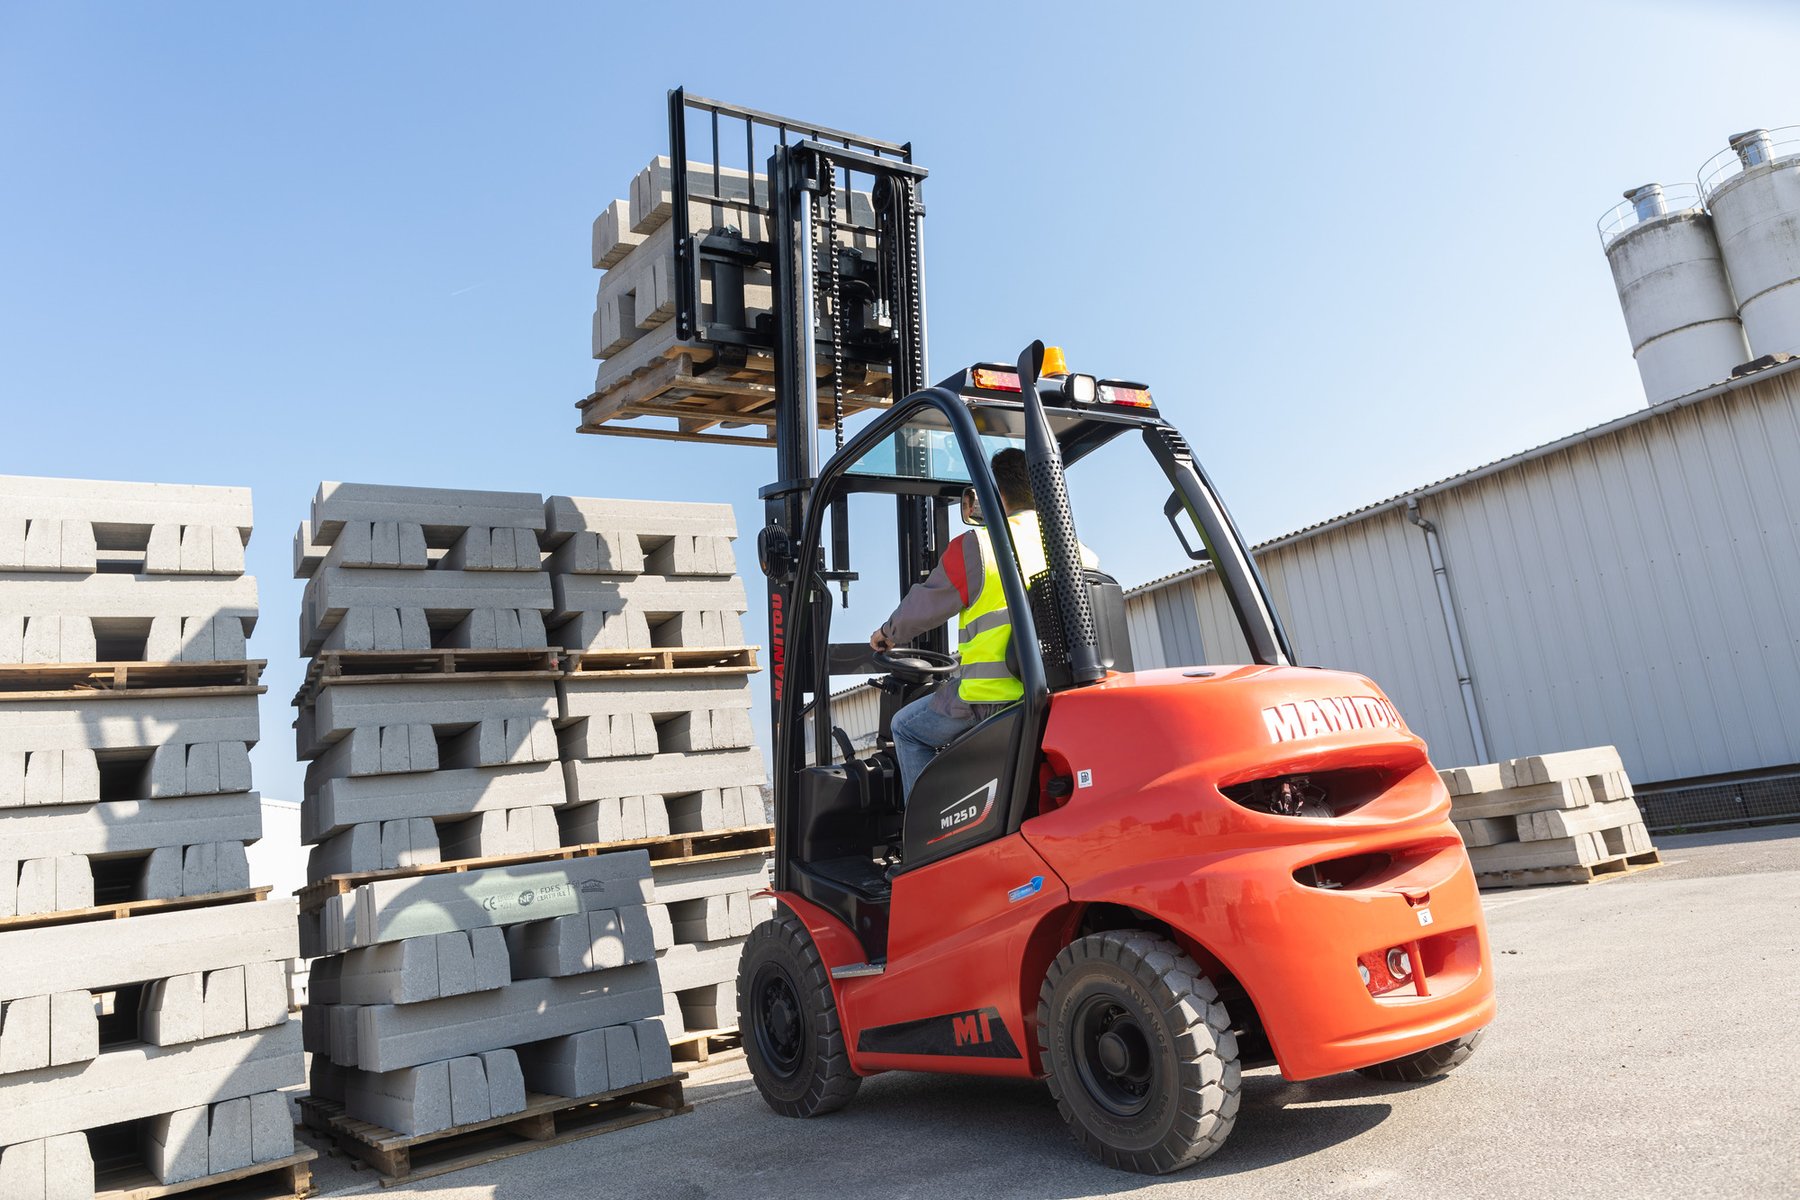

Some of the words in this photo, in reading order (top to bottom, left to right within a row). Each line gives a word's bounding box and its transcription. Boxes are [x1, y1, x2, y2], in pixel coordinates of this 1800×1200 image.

[772, 593, 785, 700] MANITOU
[1262, 697, 1401, 744] MANITOU
[952, 1012, 992, 1047] MI
